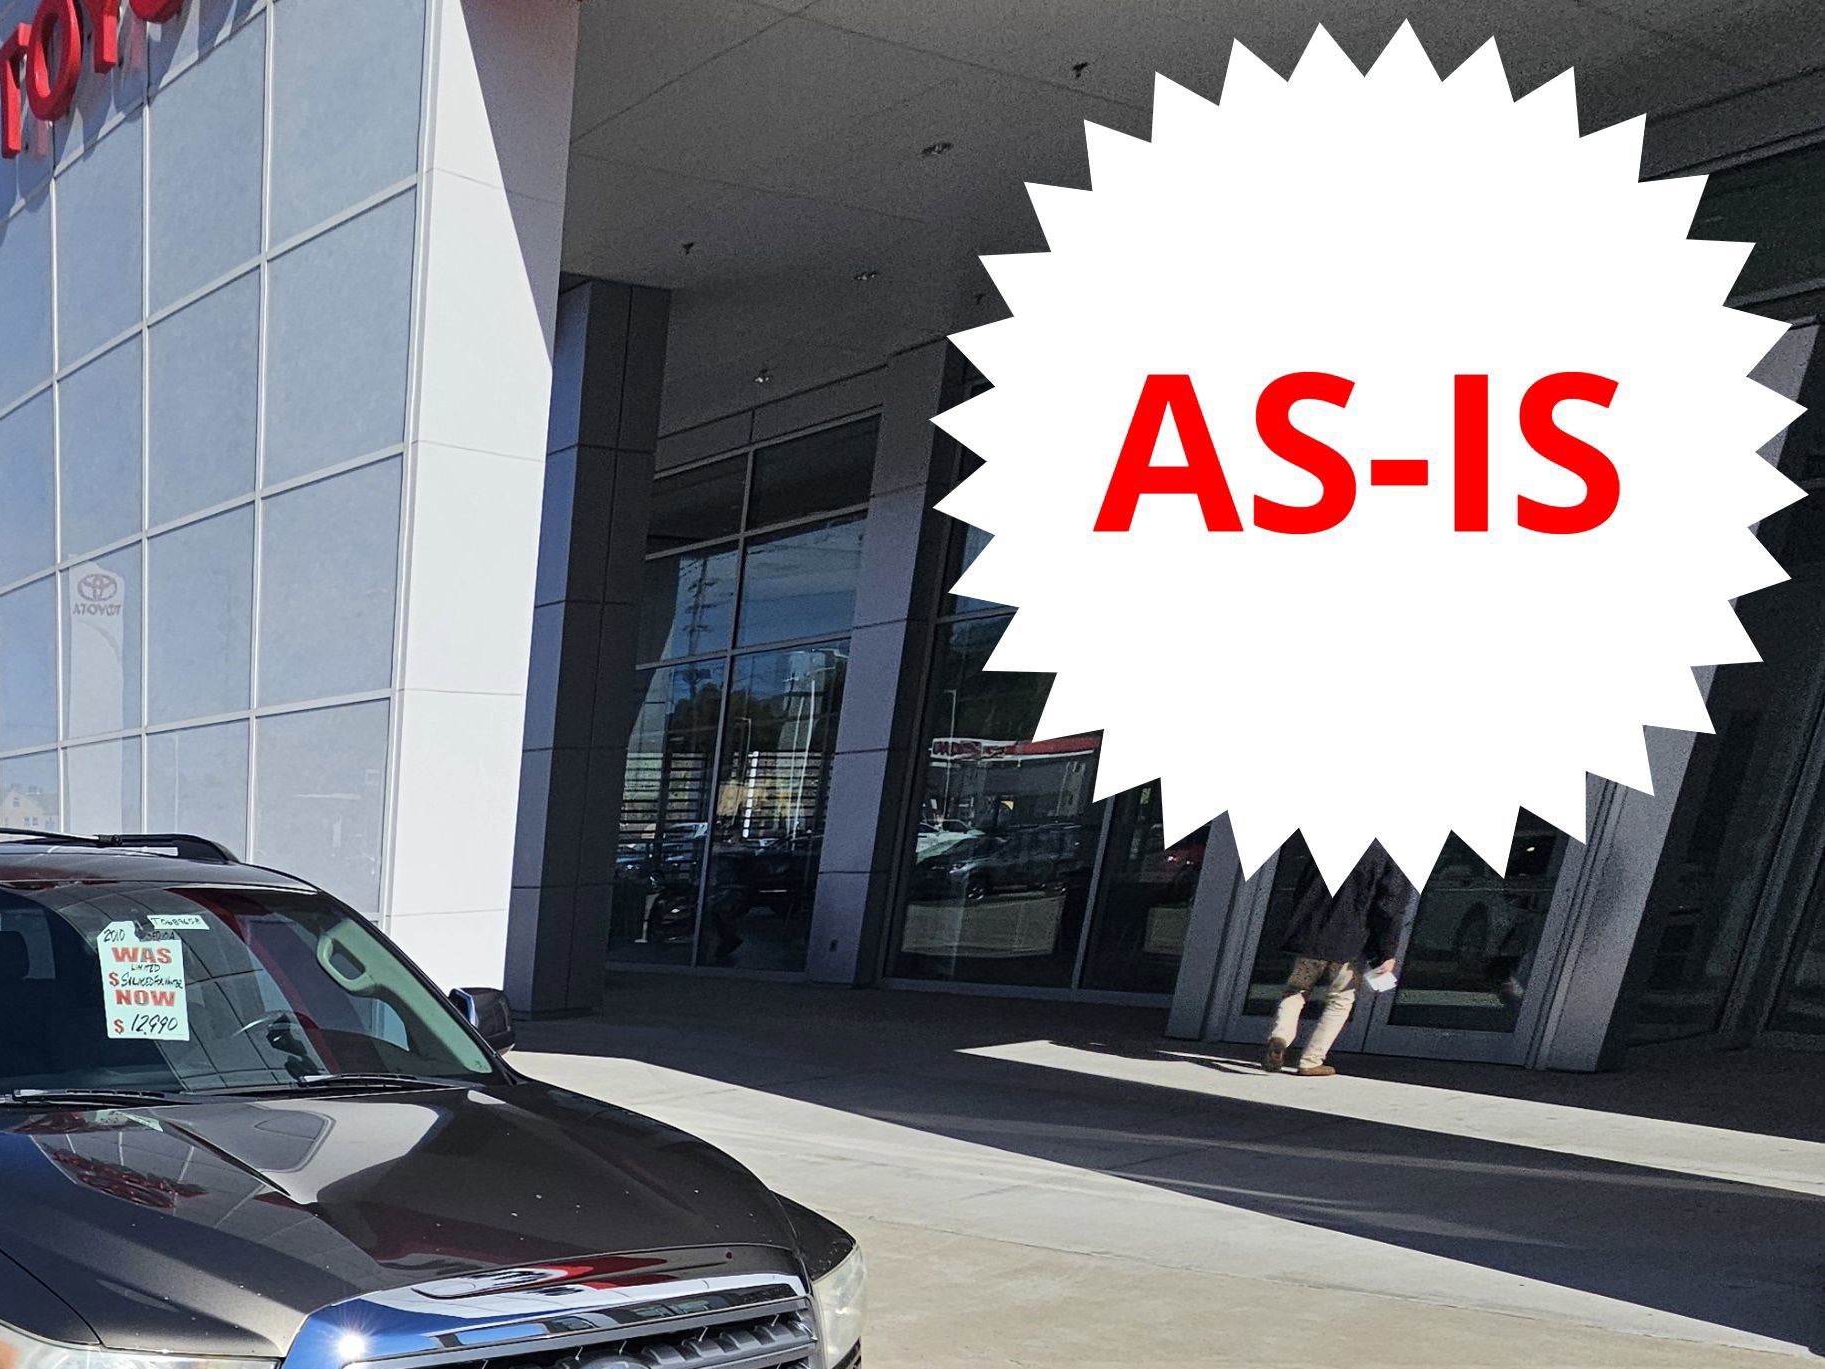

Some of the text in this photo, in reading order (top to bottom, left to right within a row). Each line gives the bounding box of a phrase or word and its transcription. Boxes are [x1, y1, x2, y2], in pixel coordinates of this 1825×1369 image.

[103, 929, 126, 942] 2010
[111, 947, 172, 964] WAS
[109, 971, 120, 987] $
[115, 989, 176, 1007] NOW
[114, 1018, 124, 1034] $
